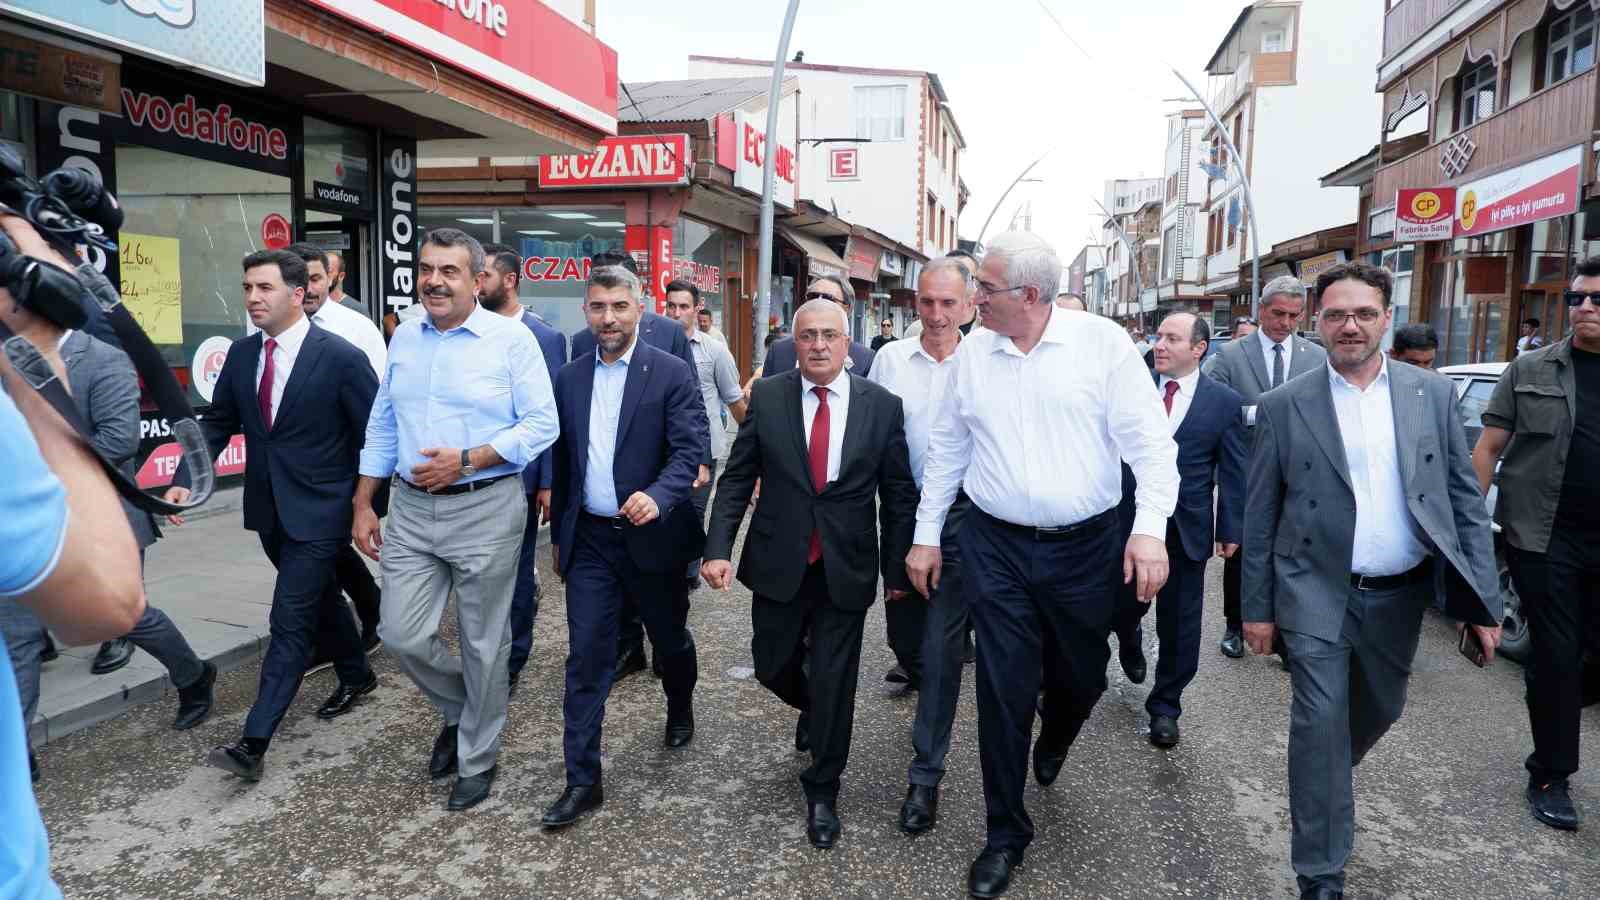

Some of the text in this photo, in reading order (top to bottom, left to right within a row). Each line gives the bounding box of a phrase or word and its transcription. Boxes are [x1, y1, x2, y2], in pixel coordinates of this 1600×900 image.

[121, 88, 288, 159] vodafone
[548, 143, 676, 180] ECZANE
[836, 152, 852, 173] E
[318, 187, 360, 205] vodafone
[1415, 199, 1436, 212] CP
[518, 256, 592, 281] CZA
[140, 418, 176, 439] PAS
